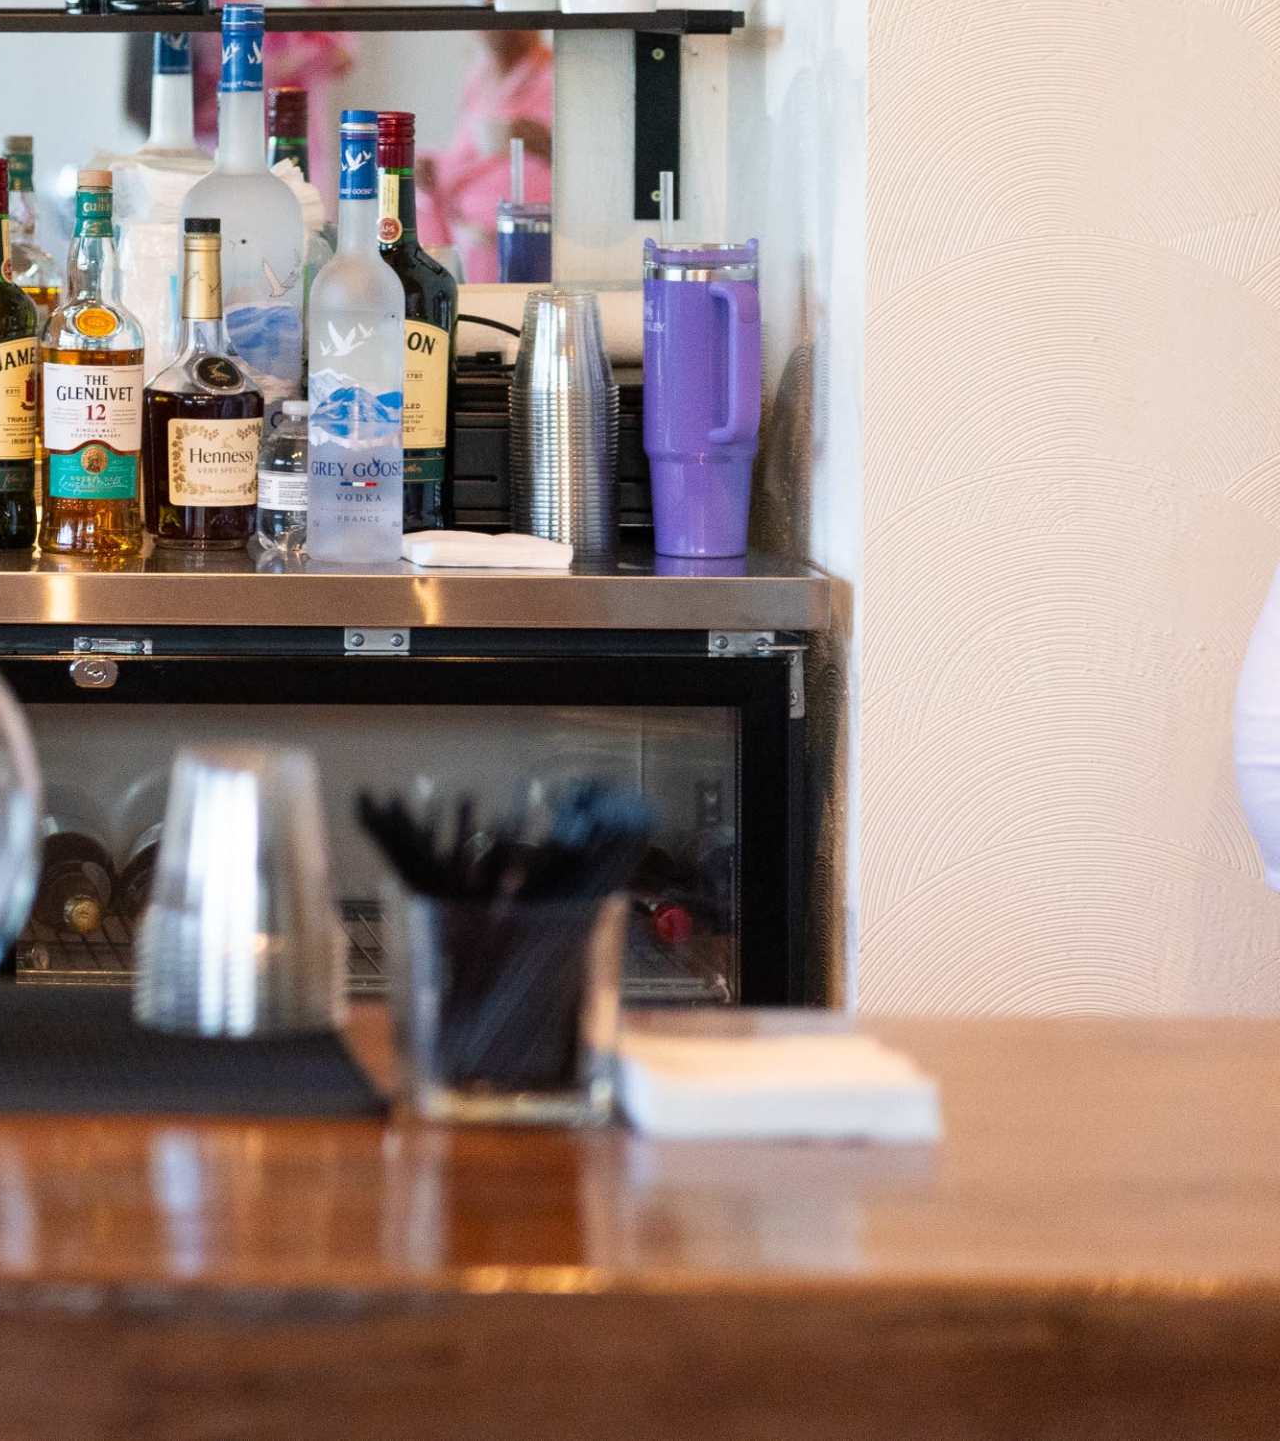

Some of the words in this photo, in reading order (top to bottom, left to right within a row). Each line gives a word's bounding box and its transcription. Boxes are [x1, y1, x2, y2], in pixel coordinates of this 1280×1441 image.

[85, 375, 109, 386] THE
[57, 386, 134, 402] GLENLIVET
[86, 404, 107, 421] 12
[311, 461, 348, 477] GREY
[352, 457, 401, 477] GOOS
[335, 493, 382, 502] VODKA
